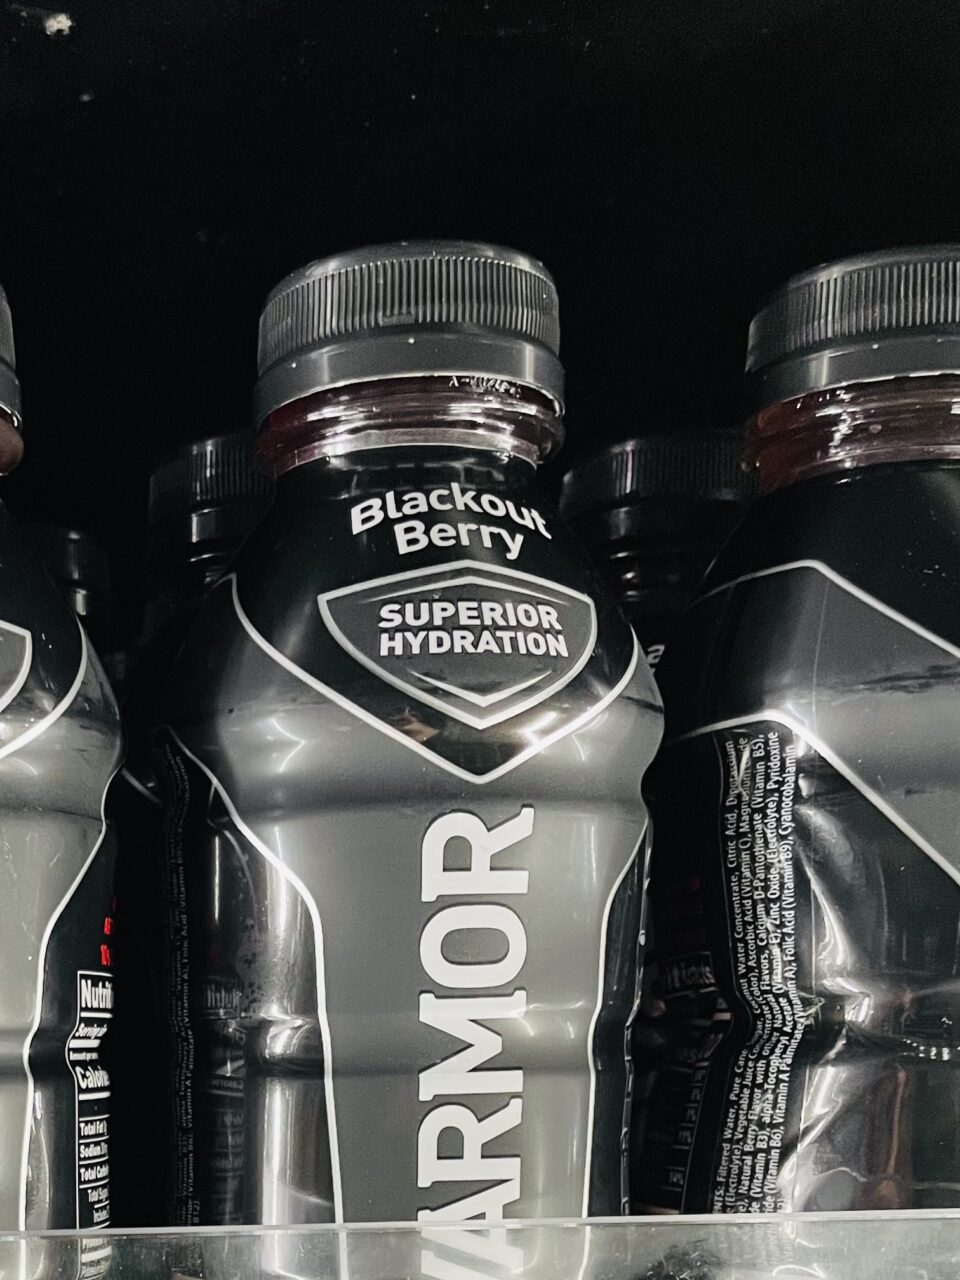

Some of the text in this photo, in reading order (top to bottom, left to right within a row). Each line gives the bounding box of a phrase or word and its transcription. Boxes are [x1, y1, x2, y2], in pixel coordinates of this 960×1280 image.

[350, 482, 552, 539] Blackout
[393, 518, 524, 560] Berry
[378, 600, 562, 631] SUPERIOR
[379, 629, 569, 659] HYDRATION
[766, 731, 783, 790] Pyridoxine
[778, 745, 796, 836] Cyanocobalamin
[767, 867, 780, 898] Oxide
[781, 861, 796, 908] (Vitamin
[769, 902, 780, 925] Zinc
[782, 910, 795, 934] Acid
[782, 935, 795, 961] Folic
[734, 851, 757, 1139] Vegetable Juice Ascorbic Acid (Vitamin
[738, 761, 783, 1194] Natural Berry Flavor with other Natural Flavors, Calcium D-Pantothenate (Vitamin
[730, 1077, 741, 1100] Pure
[737, 942, 746, 975] Water
[778, 997, 793, 1032] Acetate
[779, 1022, 805, 1071] Palmitate
[778, 1072, 790, 1081] A
[772, 1082, 788, 1123] Vitamin
[756, 1127, 771, 1149] B3),
[769, 1126, 784, 1147] B6),
[750, 1153, 766, 1197] (Vitamin
[763, 1148, 780, 1194] (Vitamin
